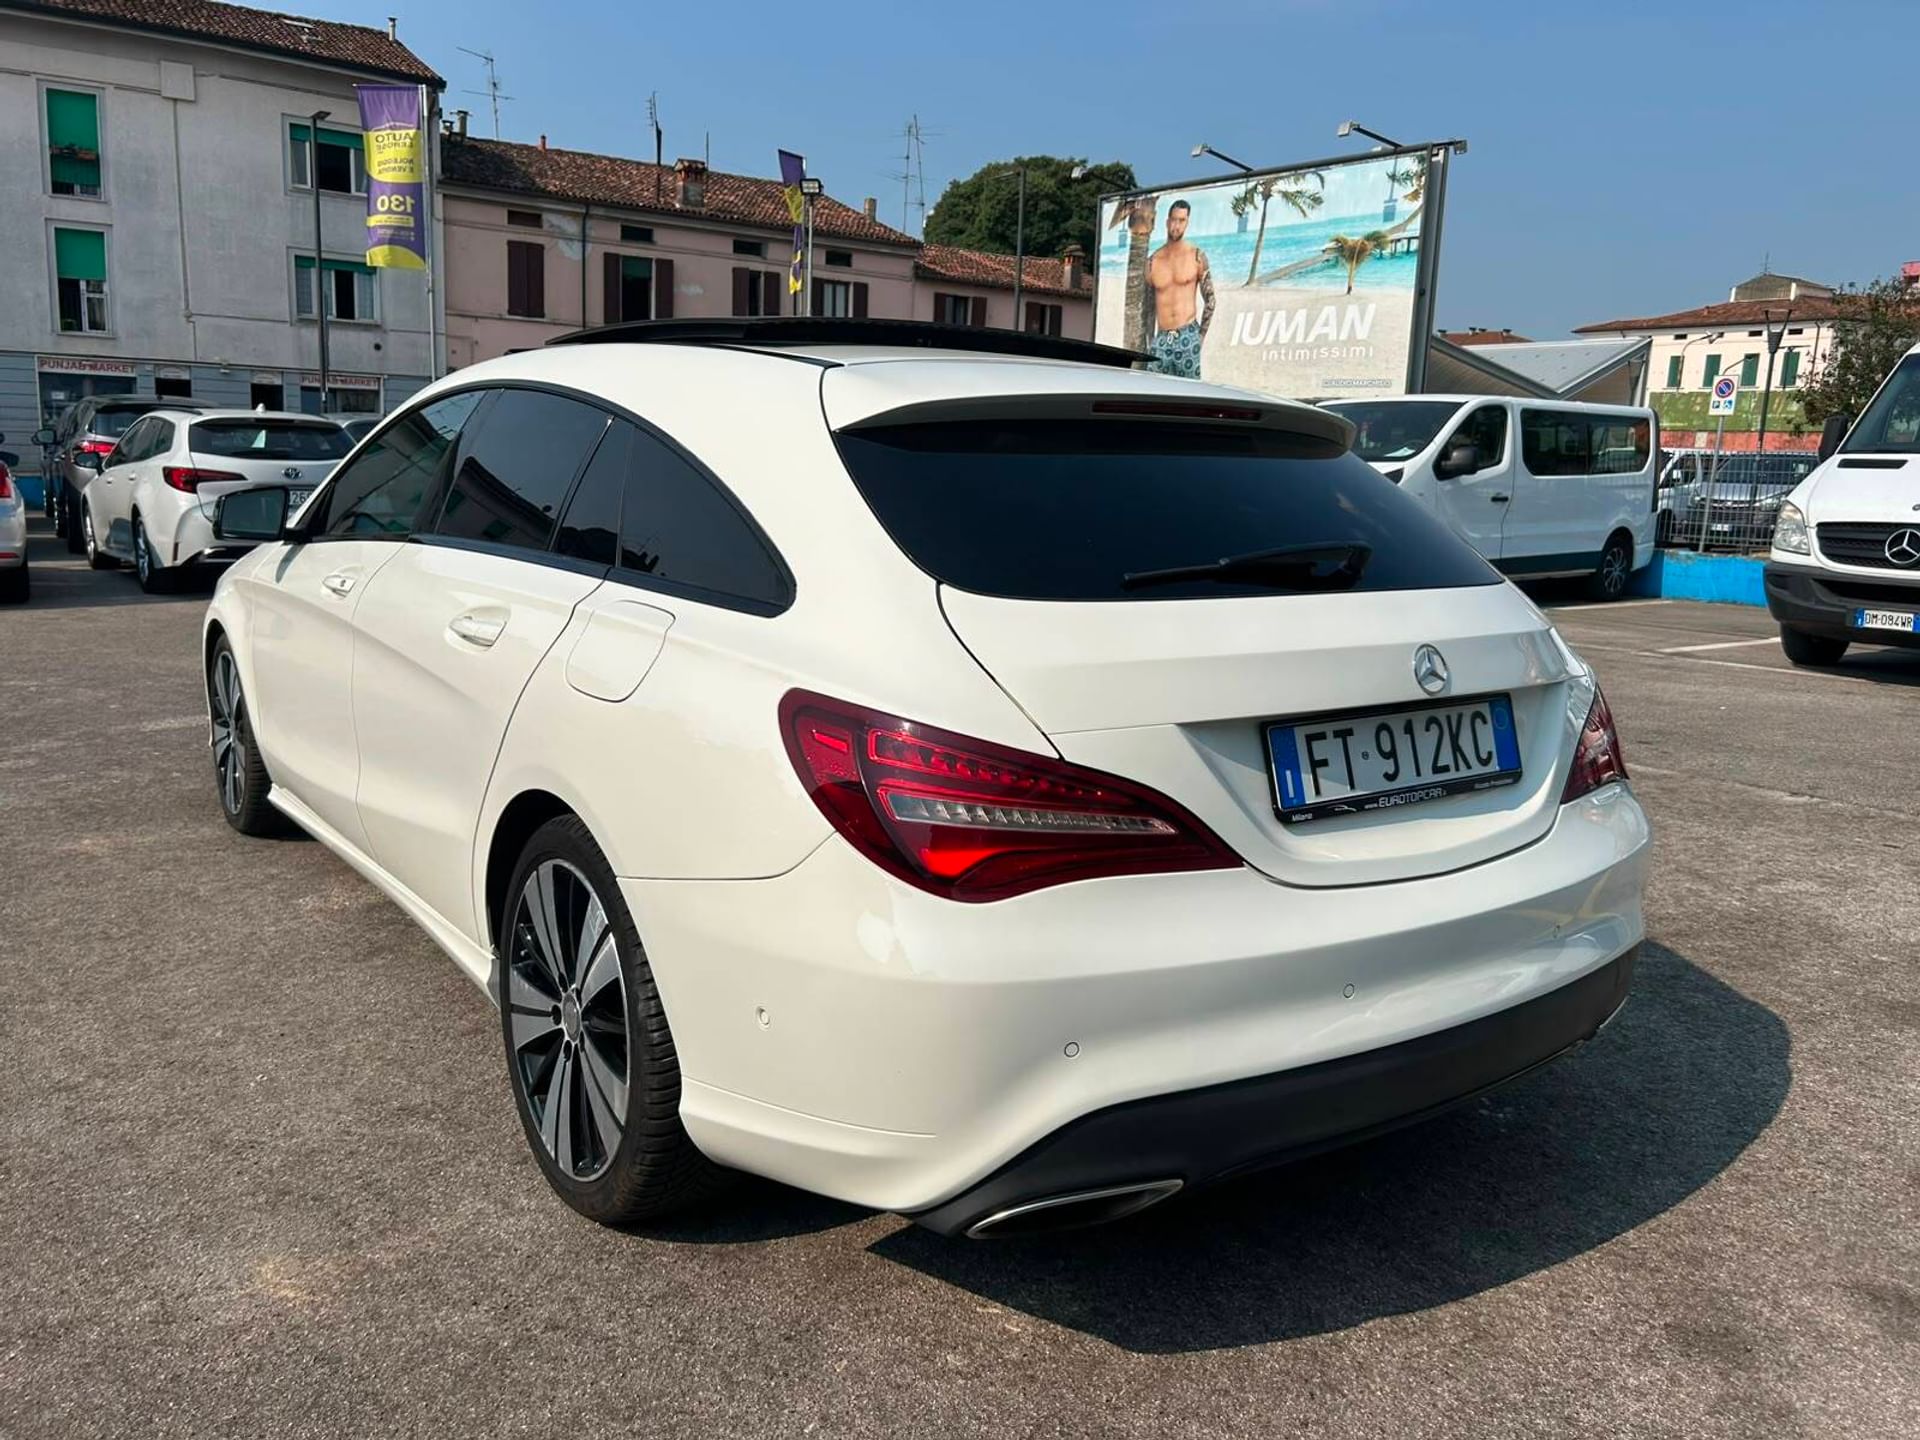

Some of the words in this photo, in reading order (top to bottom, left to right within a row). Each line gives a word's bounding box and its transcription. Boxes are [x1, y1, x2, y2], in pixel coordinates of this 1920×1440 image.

[1262, 346, 1373, 362] intimissimi
[40, 359, 87, 371] PUNJAB
[89, 361, 135, 373] MARKET
[302, 375, 337, 385] PUNAB
